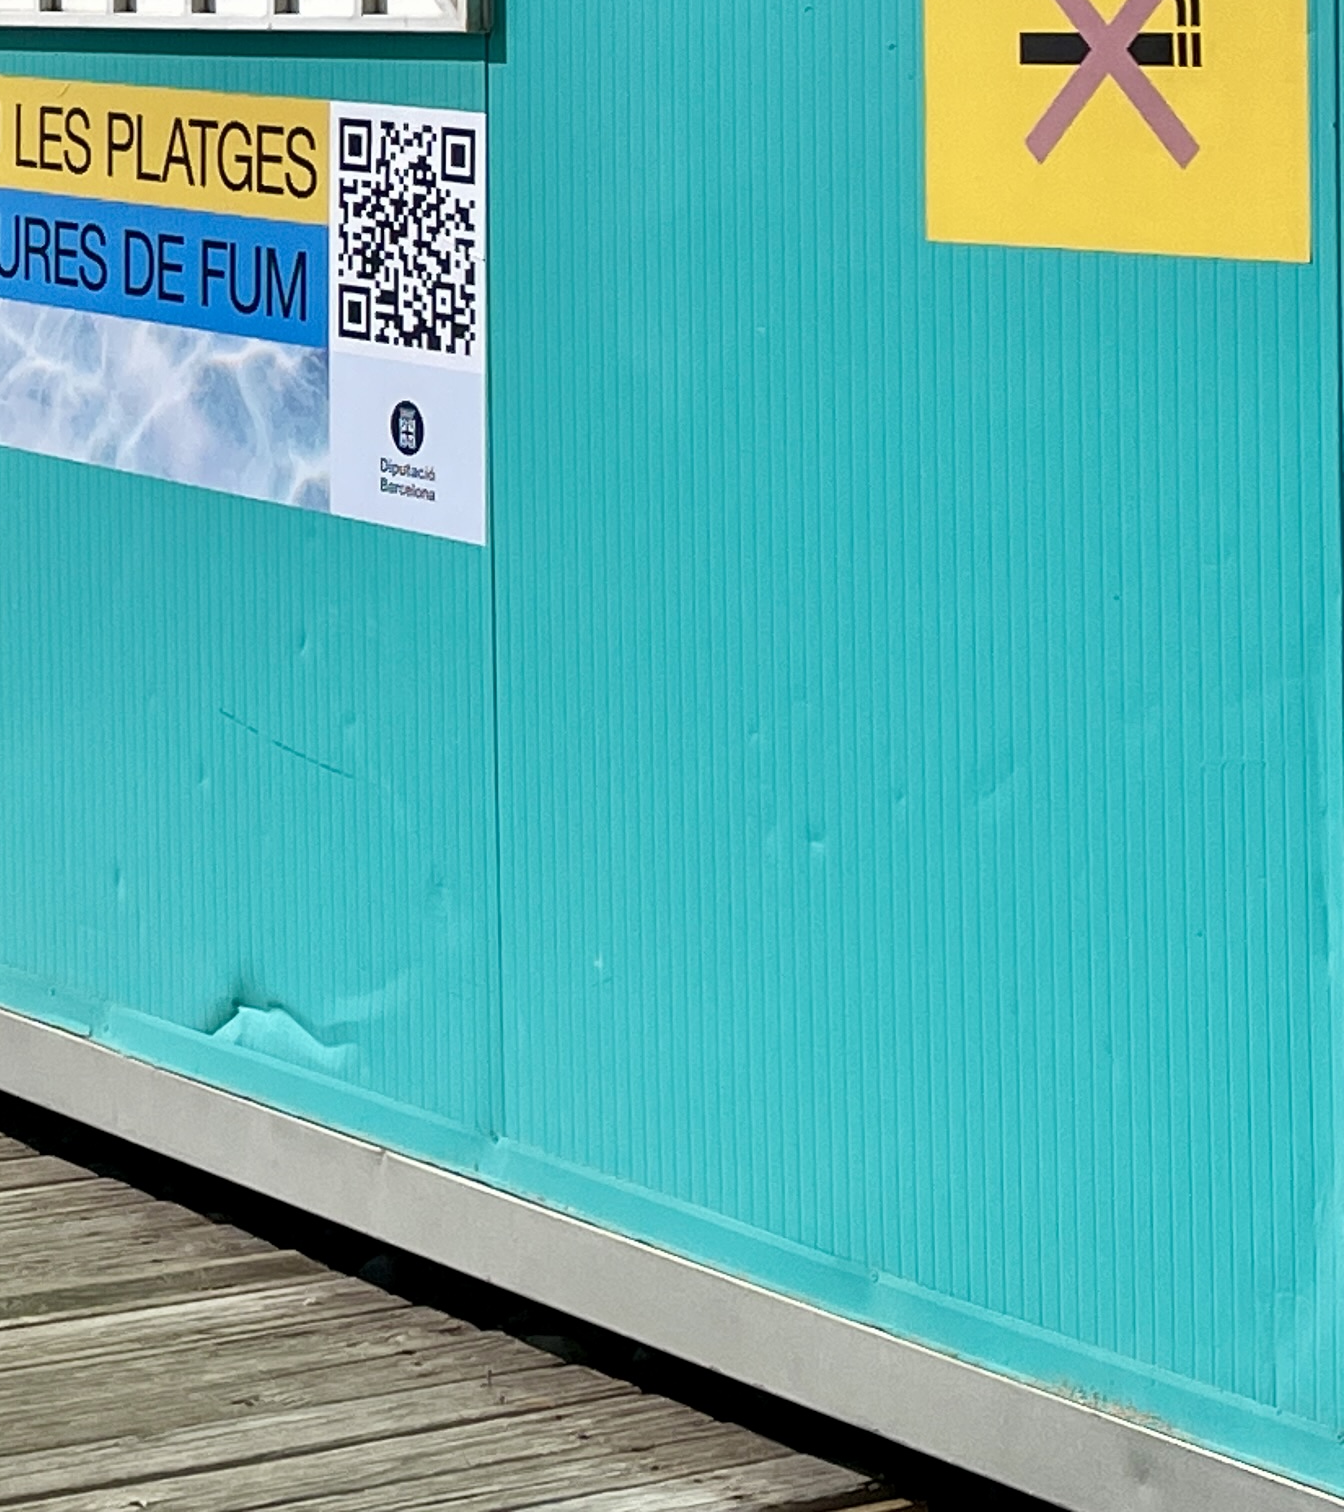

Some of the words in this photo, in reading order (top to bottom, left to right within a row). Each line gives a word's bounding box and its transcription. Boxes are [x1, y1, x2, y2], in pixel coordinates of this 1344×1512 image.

[14, 102, 92, 175] LES
[106, 110, 318, 200] PLATGES
[123, 229, 185, 304] DE
[201, 239, 308, 322] FUM
[380, 457, 435, 481] Diputació
[380, 476, 435, 501] Barcelona
